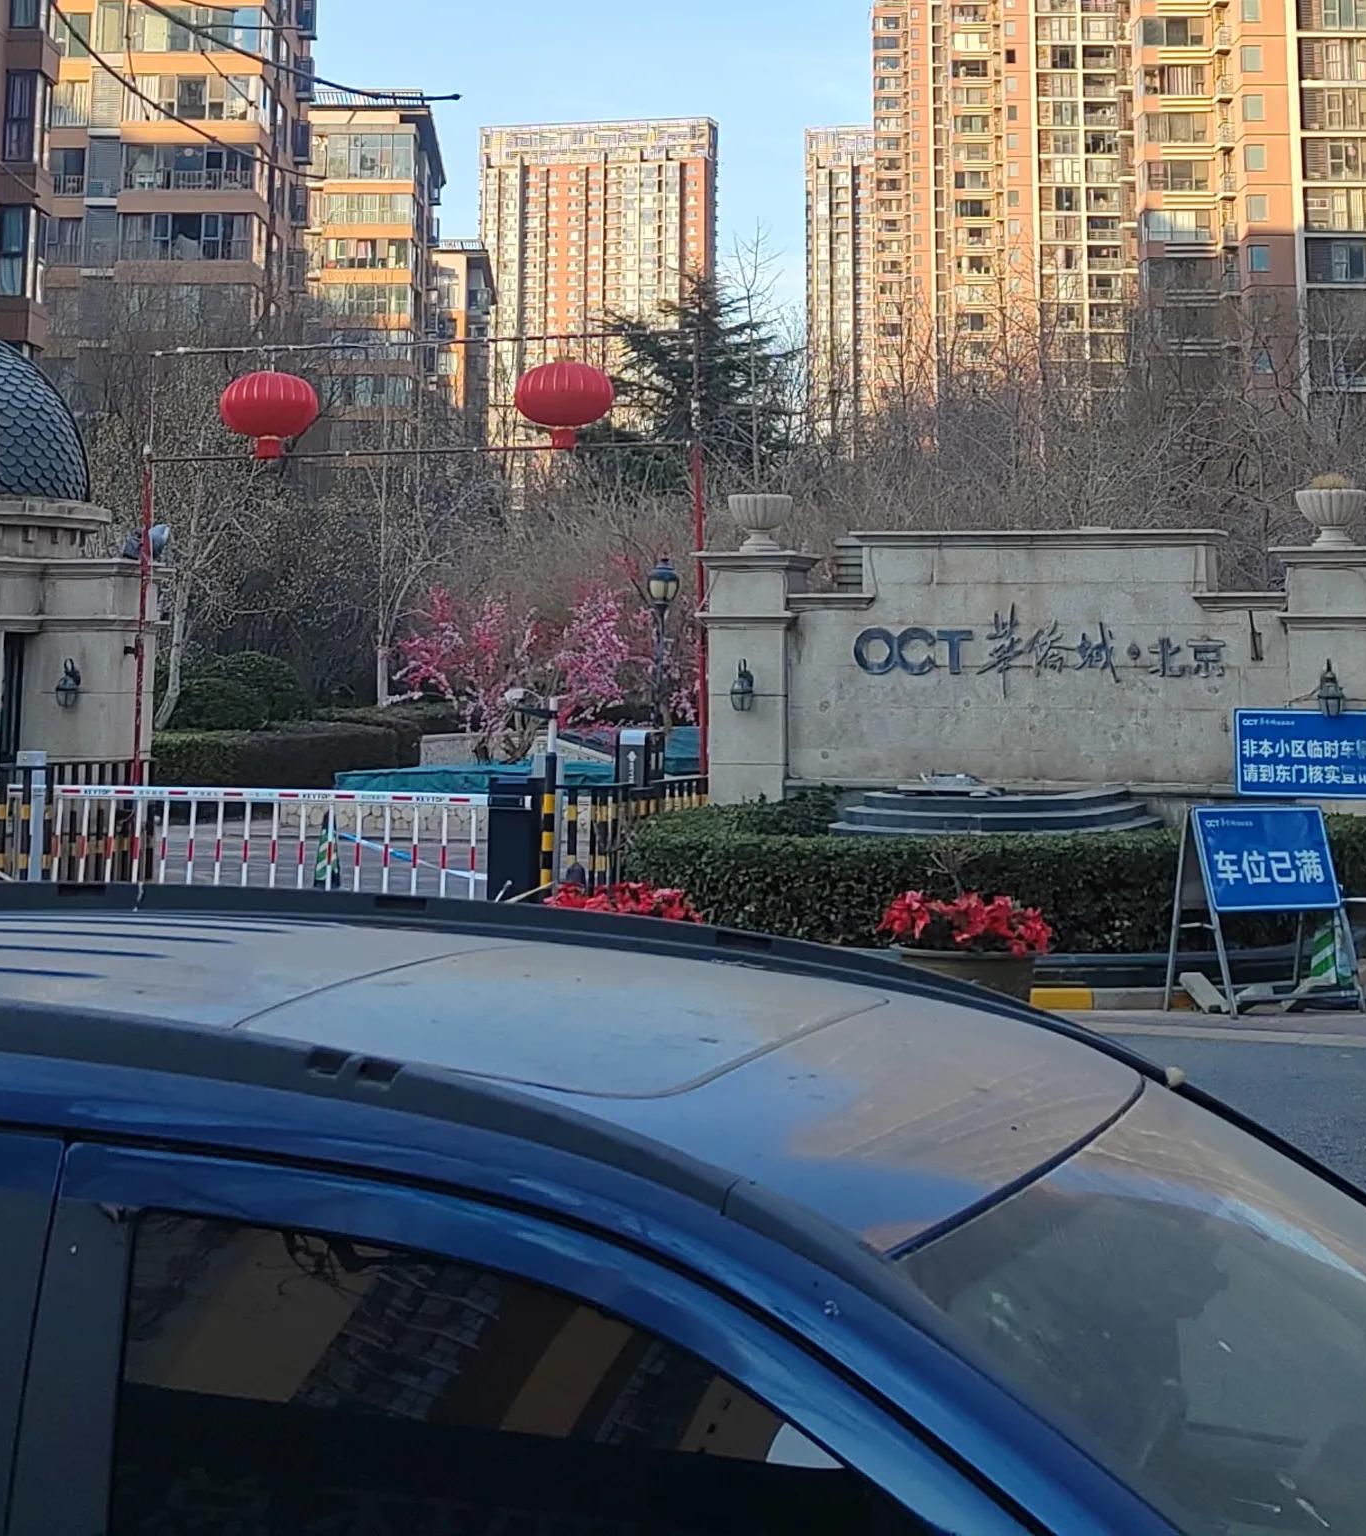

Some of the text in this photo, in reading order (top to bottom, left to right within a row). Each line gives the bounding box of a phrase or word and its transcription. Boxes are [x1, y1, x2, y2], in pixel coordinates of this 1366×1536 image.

[853, 626, 973, 675] OCT
[1213, 850, 1325, 885] 车位已满
